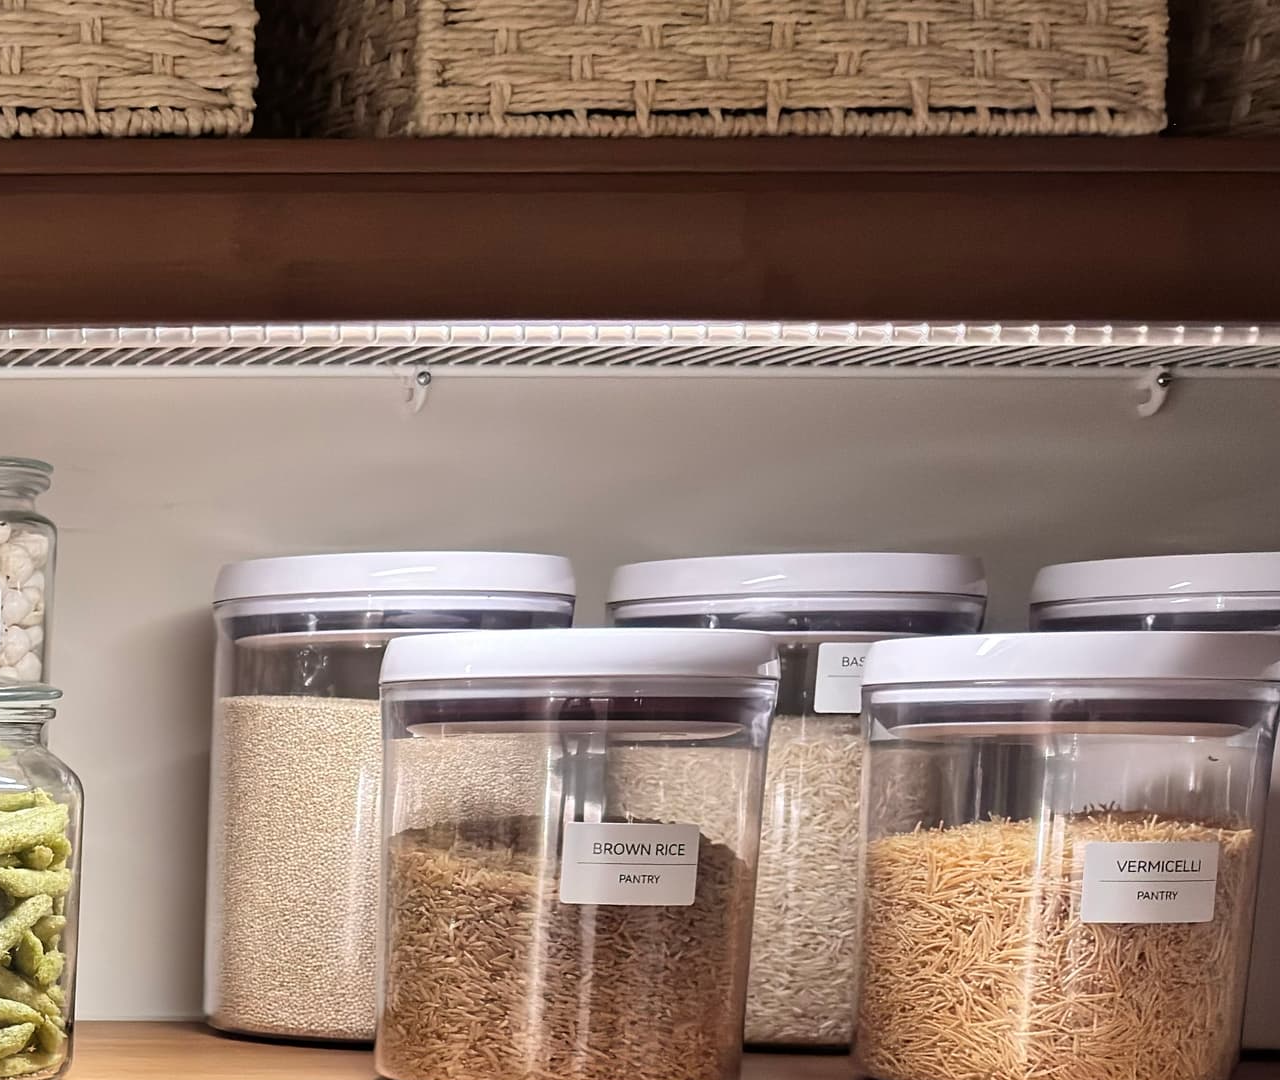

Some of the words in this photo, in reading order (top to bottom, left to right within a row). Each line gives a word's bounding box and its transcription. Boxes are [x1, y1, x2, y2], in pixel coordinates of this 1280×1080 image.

[592, 842, 651, 856] BROWN
[655, 843, 686, 857] RICE
[1116, 859, 1202, 873] VERMICELLI
[618, 873, 661, 885] PANTRY
[1136, 890, 1179, 901] PANTRY
